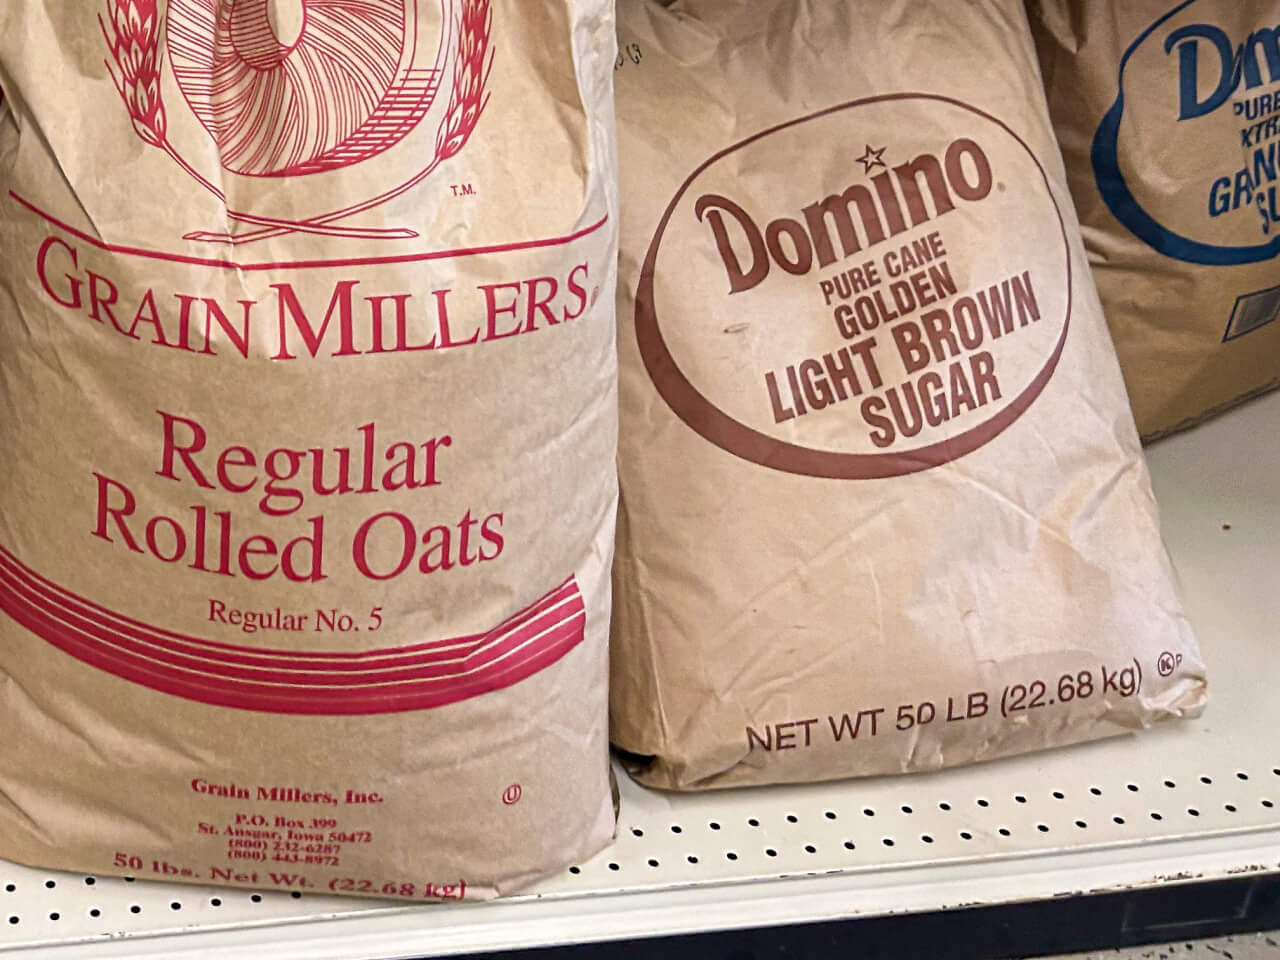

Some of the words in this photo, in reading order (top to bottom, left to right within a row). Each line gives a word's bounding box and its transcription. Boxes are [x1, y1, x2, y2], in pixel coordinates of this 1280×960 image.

[695, 137, 995, 295] Domino
[36, 235, 258, 360] GRAIN
[269, 263, 590, 362] MILLERS
[820, 252, 882, 306] PURE
[887, 231, 948, 279] CANE
[834, 262, 958, 341] GOLDEN
[764, 337, 884, 424] LIGHT
[890, 270, 1042, 376] BROWN
[860, 350, 1003, 449] SUGAR
[154, 409, 454, 517] Regular
[91, 472, 329, 584] Rolled
[351, 507, 506, 581] Oats
[208, 598, 306, 634] Regular
[313, 608, 360, 633] No.
[367, 607, 384, 632] 5
[745, 717, 820, 754] NET
[827, 707, 886, 742] WT
[895, 701, 937, 732] 50
[945, 691, 990, 723] LB
[1000, 670, 1095, 720] (22.68
[1101, 657, 1144, 698] kg)
[191, 777, 250, 801] Grain
[256, 786, 339, 808] Millers,
[344, 789, 385, 805] Inc.
[234, 812, 270, 828] P.O.
[113, 852, 144, 871] 50
[151, 857, 202, 880] lbs.
[210, 866, 260, 887] Net
[328, 875, 417, 899] (22.68
